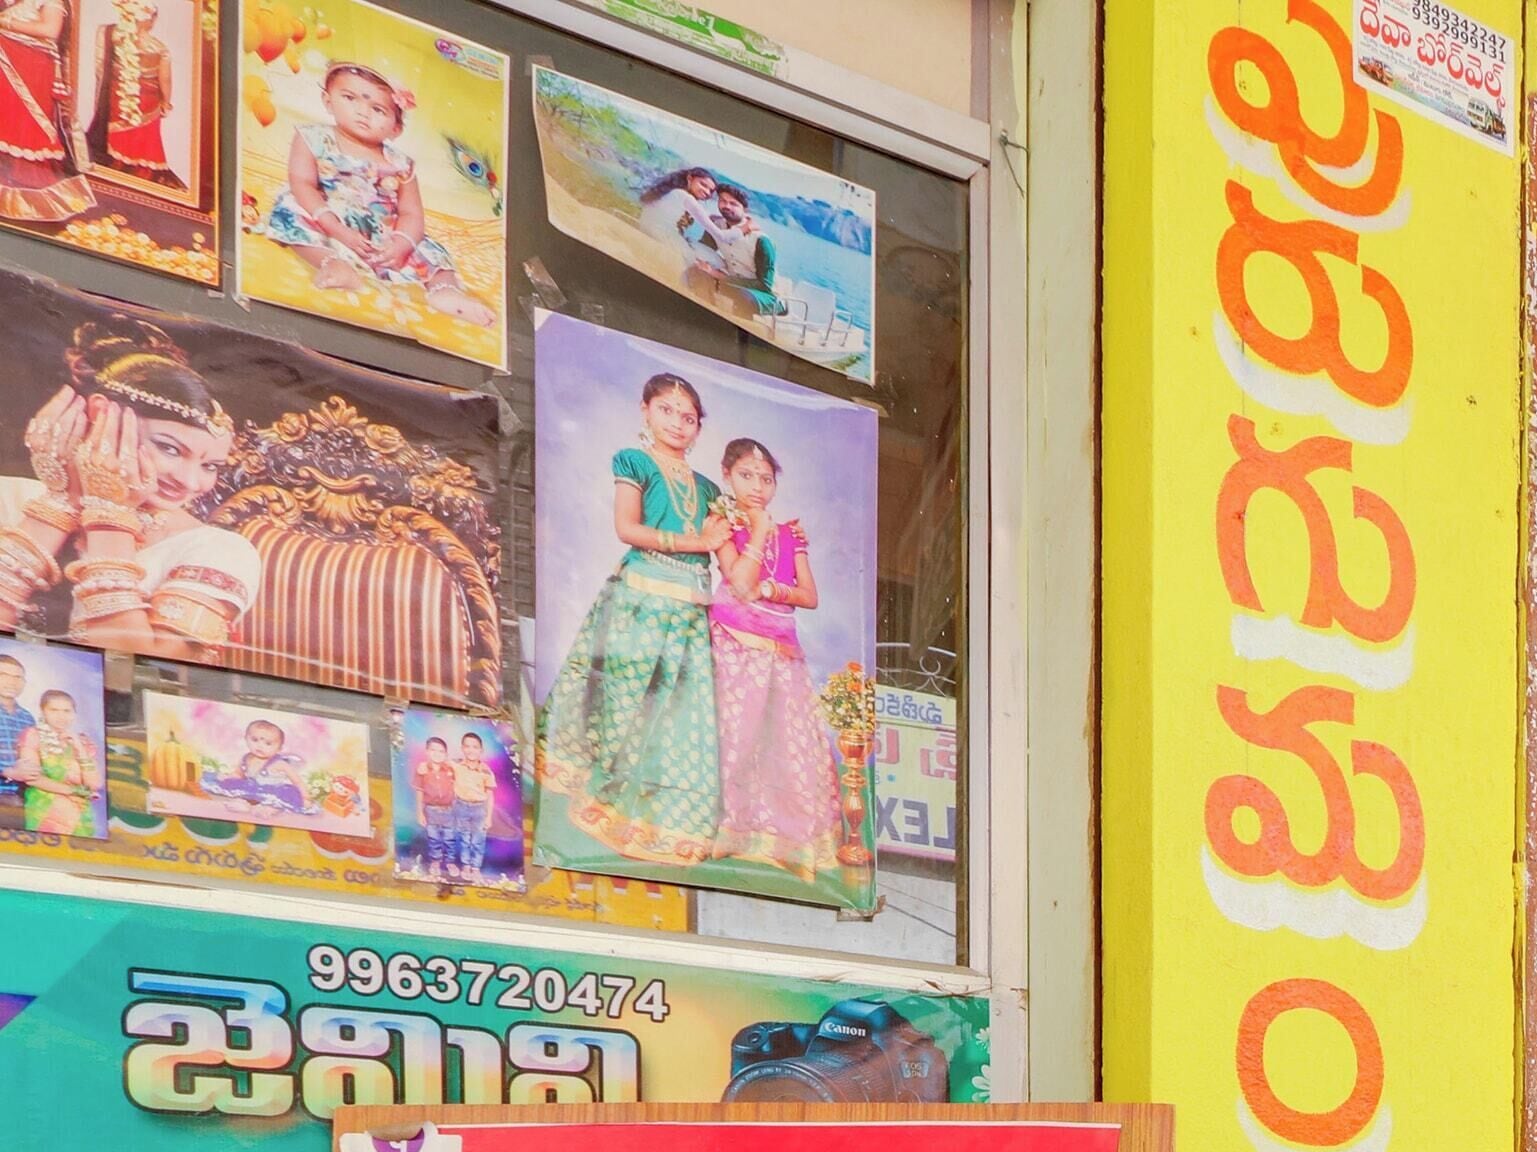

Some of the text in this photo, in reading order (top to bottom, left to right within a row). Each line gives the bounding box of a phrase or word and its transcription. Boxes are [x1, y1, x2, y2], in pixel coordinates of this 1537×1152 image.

[1412, 7, 1506, 63] 9392999131
[306, 943, 671, 1024] 9963720474
[823, 1021, 867, 1038] Canon
